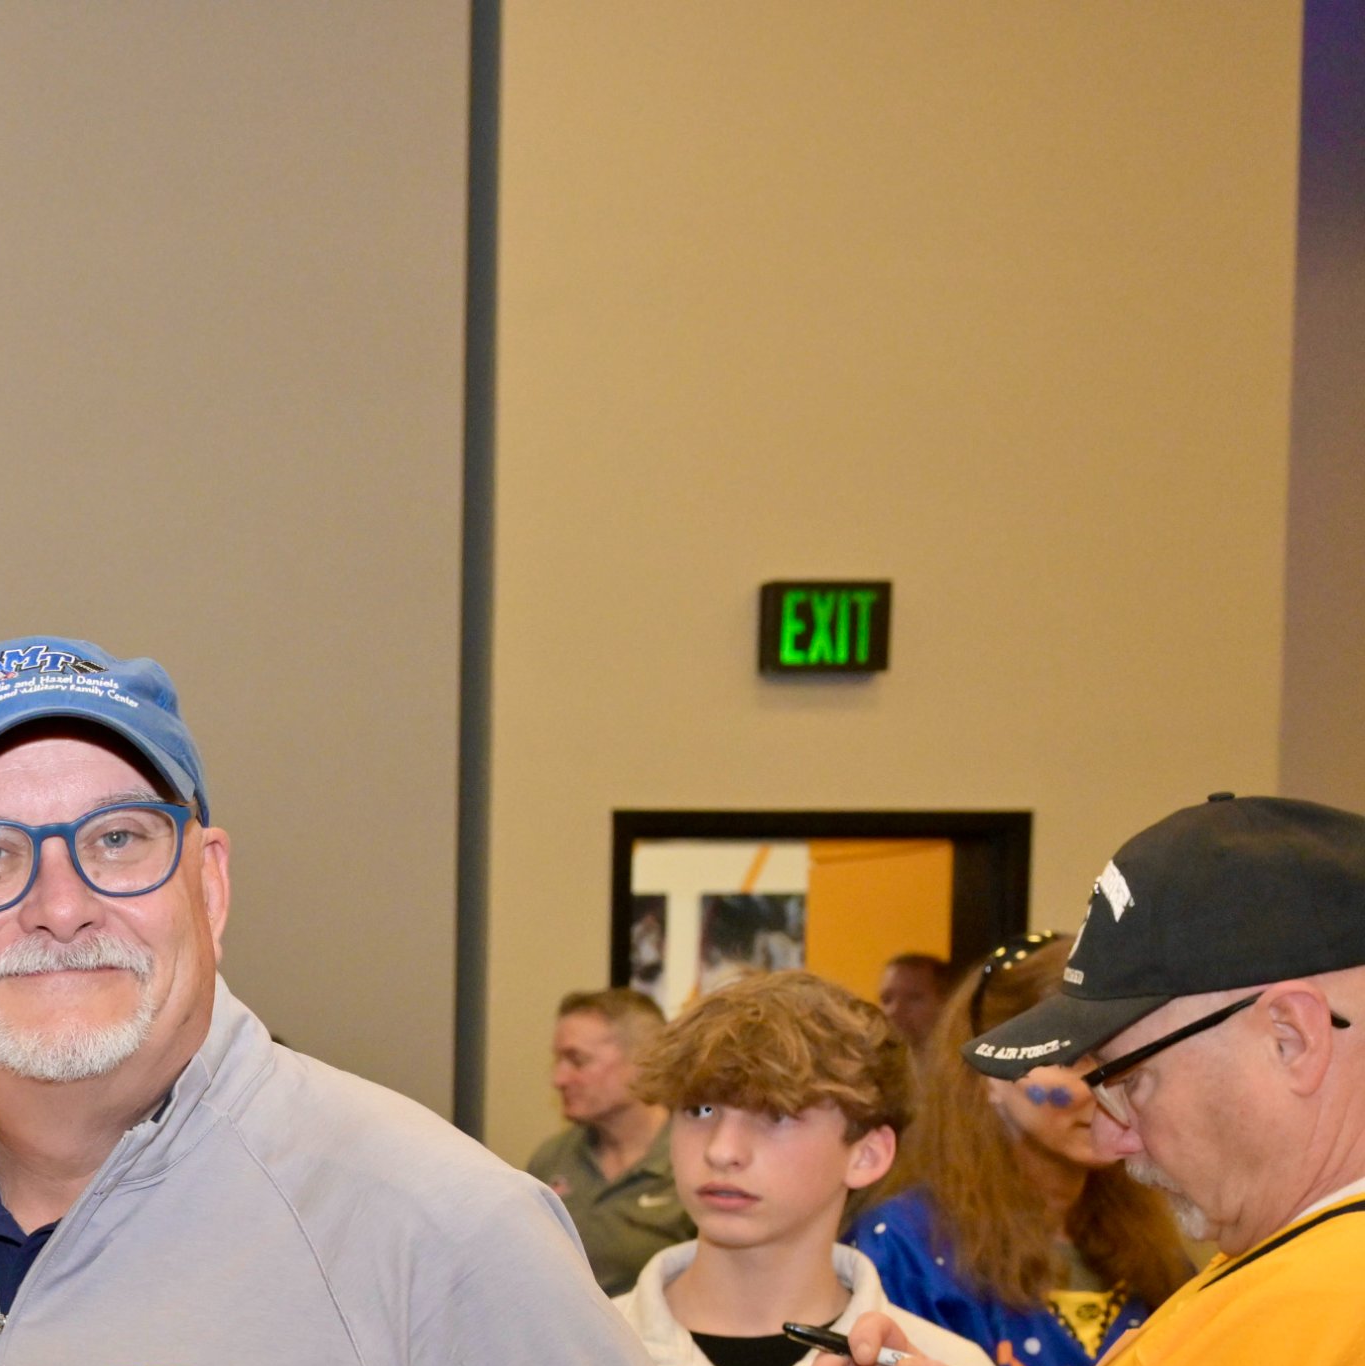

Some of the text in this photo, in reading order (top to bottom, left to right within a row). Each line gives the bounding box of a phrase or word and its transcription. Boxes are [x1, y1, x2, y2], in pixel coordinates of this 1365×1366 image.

[779, 589, 877, 665] EXIT
[1, 645, 75, 673] MT
[14, 677, 35, 689] and
[39, 675, 73, 684] Hazel
[76, 675, 119, 689] Daniels
[107, 689, 139, 708] Center
[994, 1047, 1019, 1060] AIR
[1017, 1039, 1060, 1060] FORCE
